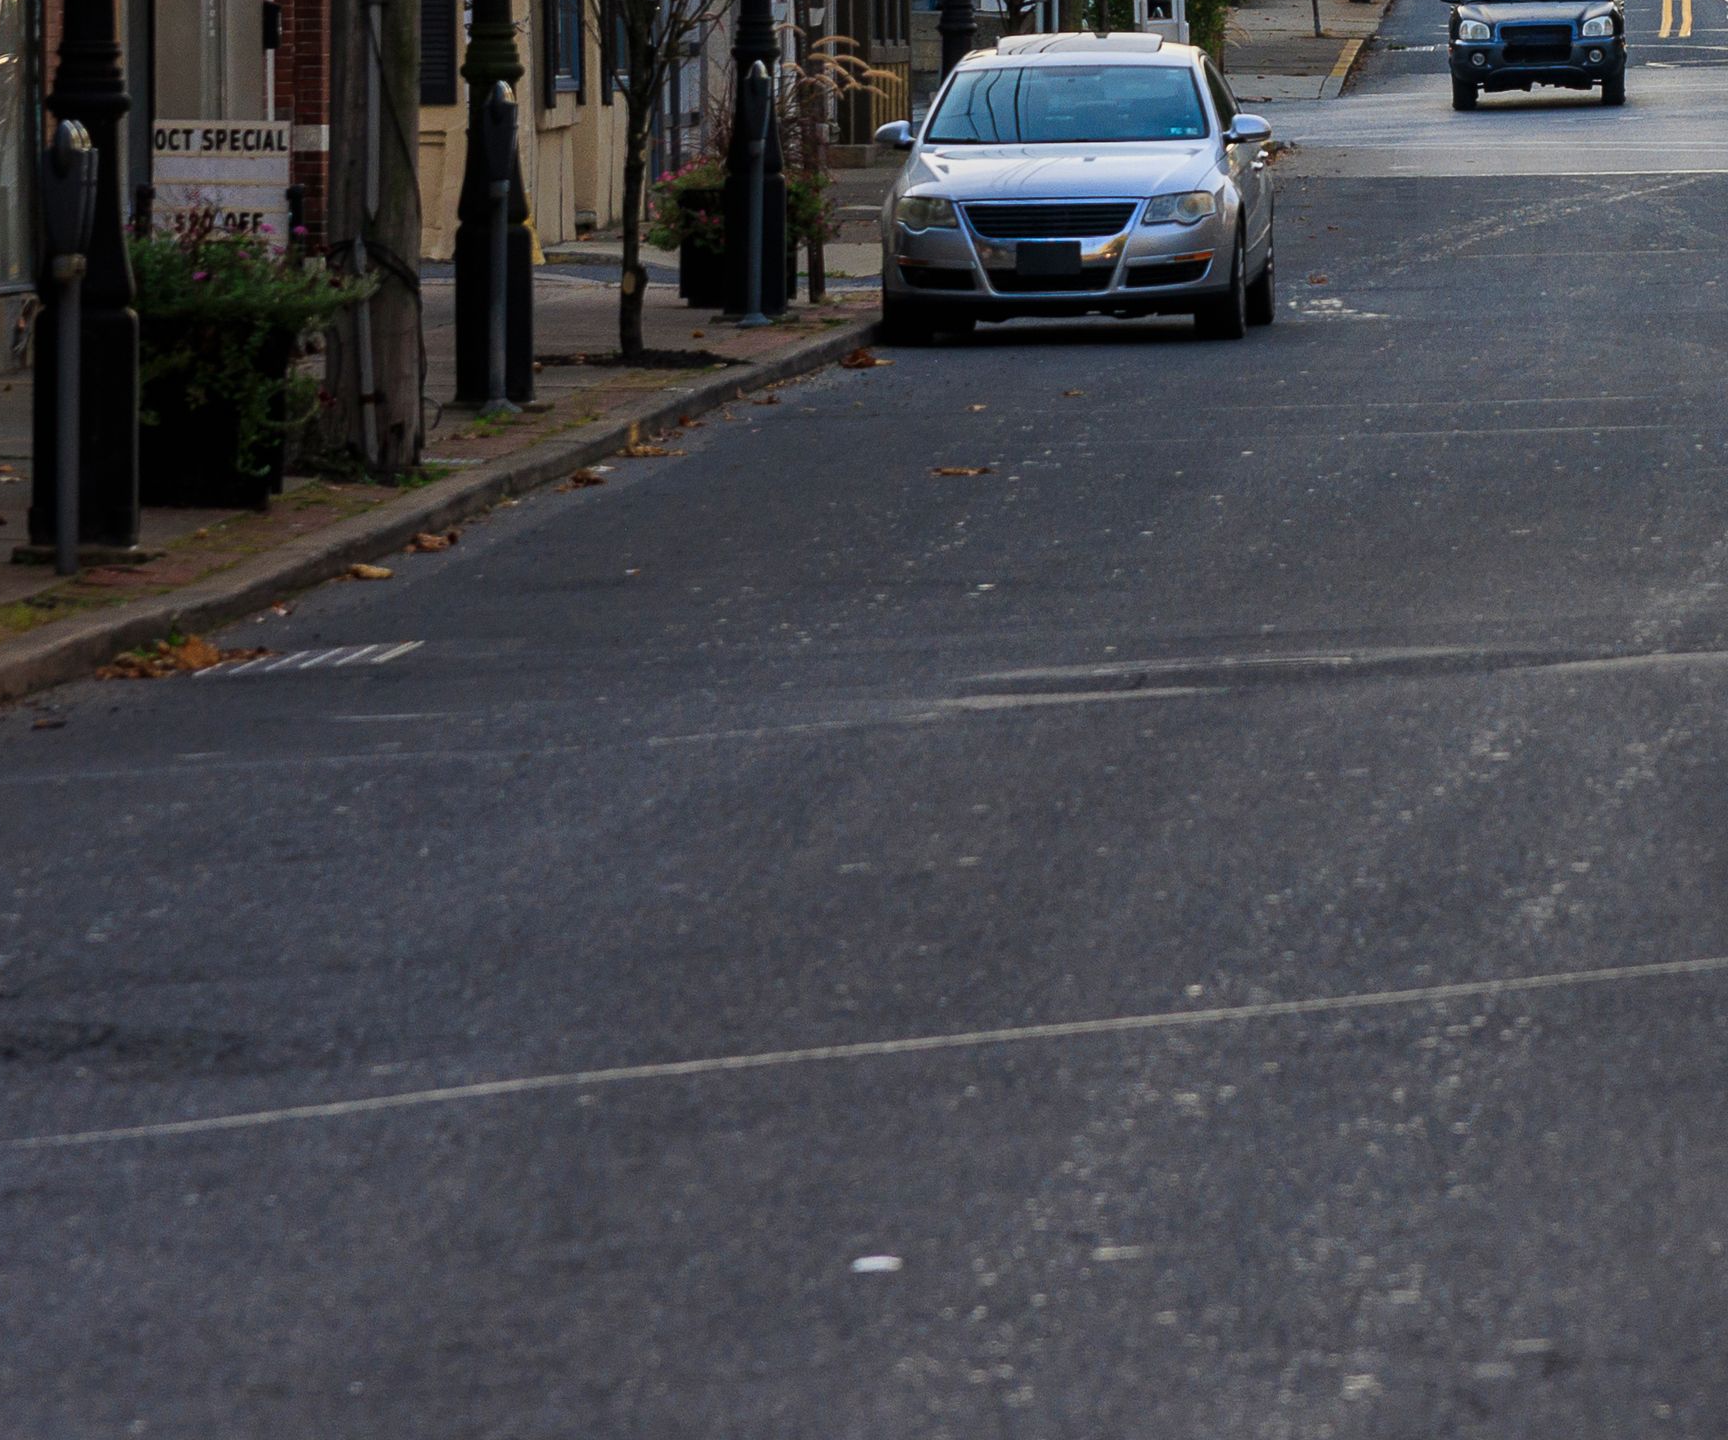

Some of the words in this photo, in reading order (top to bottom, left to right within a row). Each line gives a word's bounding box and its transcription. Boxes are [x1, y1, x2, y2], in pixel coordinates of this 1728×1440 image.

[155, 128, 194, 151] OCT
[202, 128, 288, 151] SPECIAL
[224, 212, 263, 233] OFF
